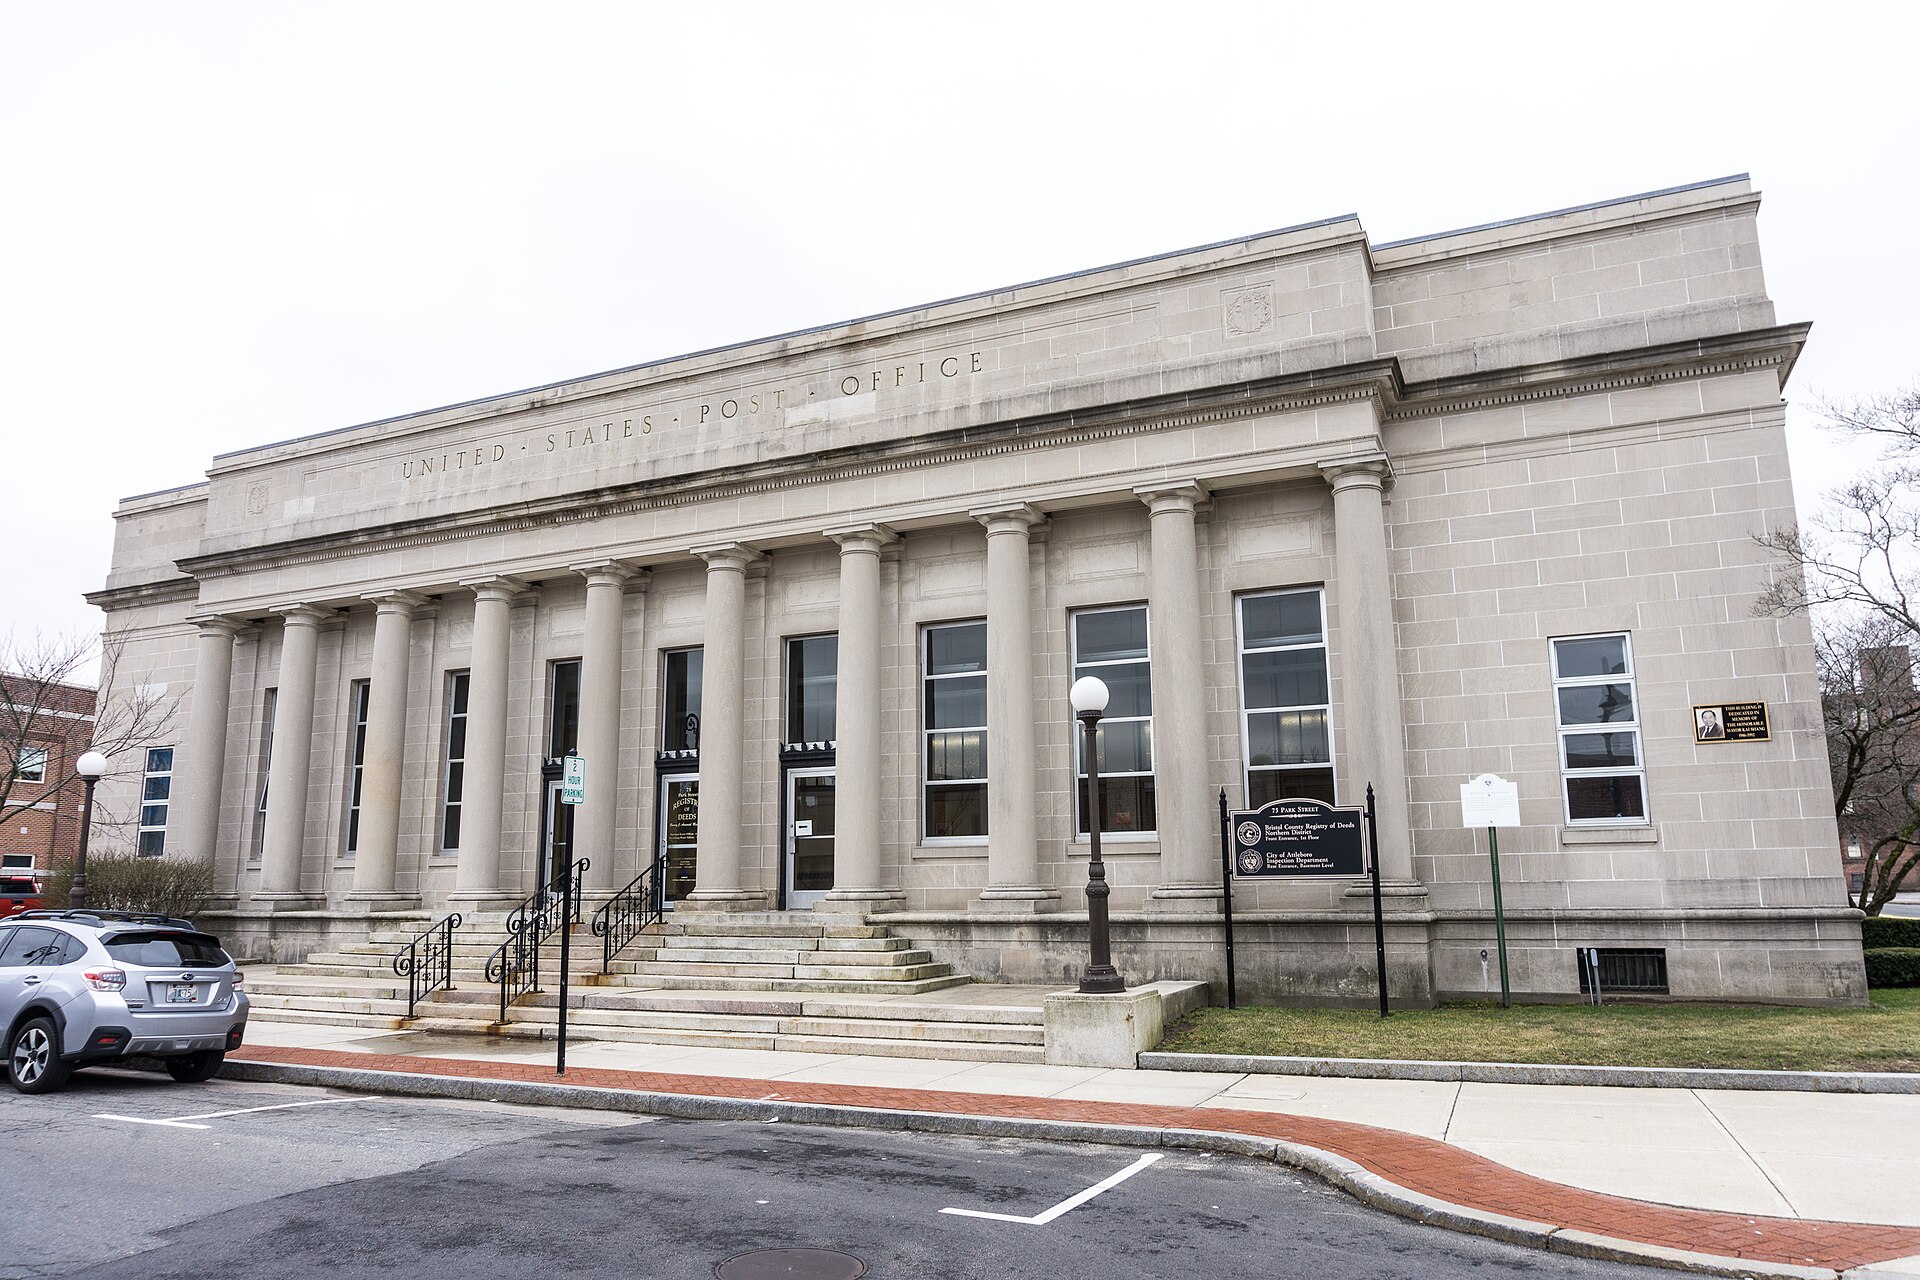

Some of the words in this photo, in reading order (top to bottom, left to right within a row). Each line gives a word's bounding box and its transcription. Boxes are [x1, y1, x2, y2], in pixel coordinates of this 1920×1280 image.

[402, 444, 505, 479] UNITED
[546, 415, 653, 453] STATES
[699, 389, 785, 424] POST
[840, 352, 983, 396] OFFICE
[572, 762, 578, 772] 2
[568, 776, 580, 785] HOUR
[564, 788, 583, 798] PARKING
[672, 797, 698, 810] REGISTR
